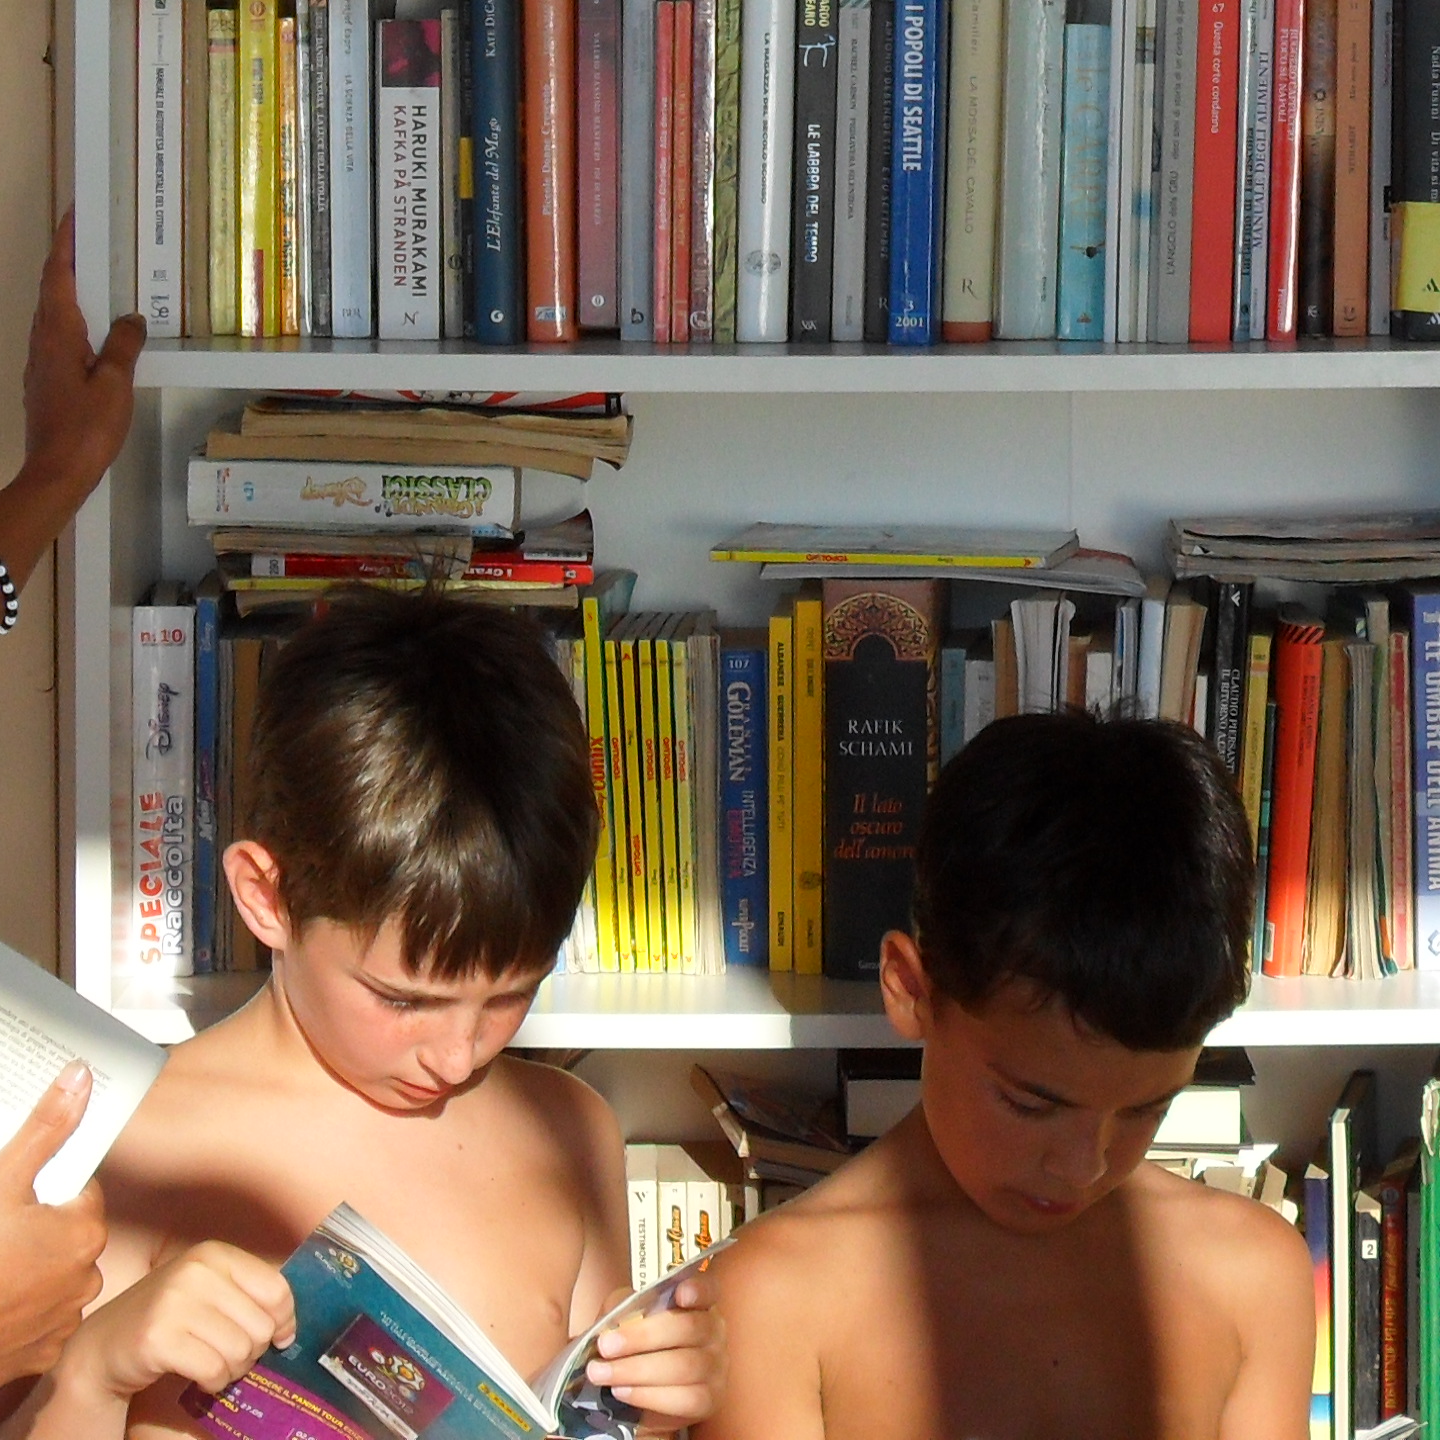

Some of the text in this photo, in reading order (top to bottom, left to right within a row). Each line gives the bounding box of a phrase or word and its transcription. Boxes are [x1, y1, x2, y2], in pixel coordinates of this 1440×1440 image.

[903, 16, 925, 78] POPOLI
[902, 82, 924, 102] DI
[808, 124, 820, 138] LE
[901, 106, 924, 172] SEATTLE
[807, 142, 820, 190] LABBRA
[393, 104, 411, 288] KAFKA PÅ STRANDEN
[485, 118, 501, 252] L'Elefante del Mago
[411, 104, 428, 298] HARUKI MURAKAMI
[806, 195, 819, 218] DEL
[894, 317, 924, 328] 2001
[381, 474, 492, 498] CLASSICI
[140, 629, 185, 645] n. 10
[727, 658, 750, 670] 107
[145, 682, 180, 760] Disney
[848, 719, 903, 735] RAFIK
[1226, 669, 1239, 774] CLAUDIO PIERSANT
[839, 740, 913, 756] SCHAMI
[853, 793, 902, 813] Il lato
[742, 790, 757, 878] INTELLIGENZA
[850, 821, 903, 835] oscuro
[138, 791, 165, 965] SPECIALE
[161, 794, 185, 956] Raccolta
[1367, 1244, 1374, 1256] 2
[348, 1355, 387, 1391] EURO
